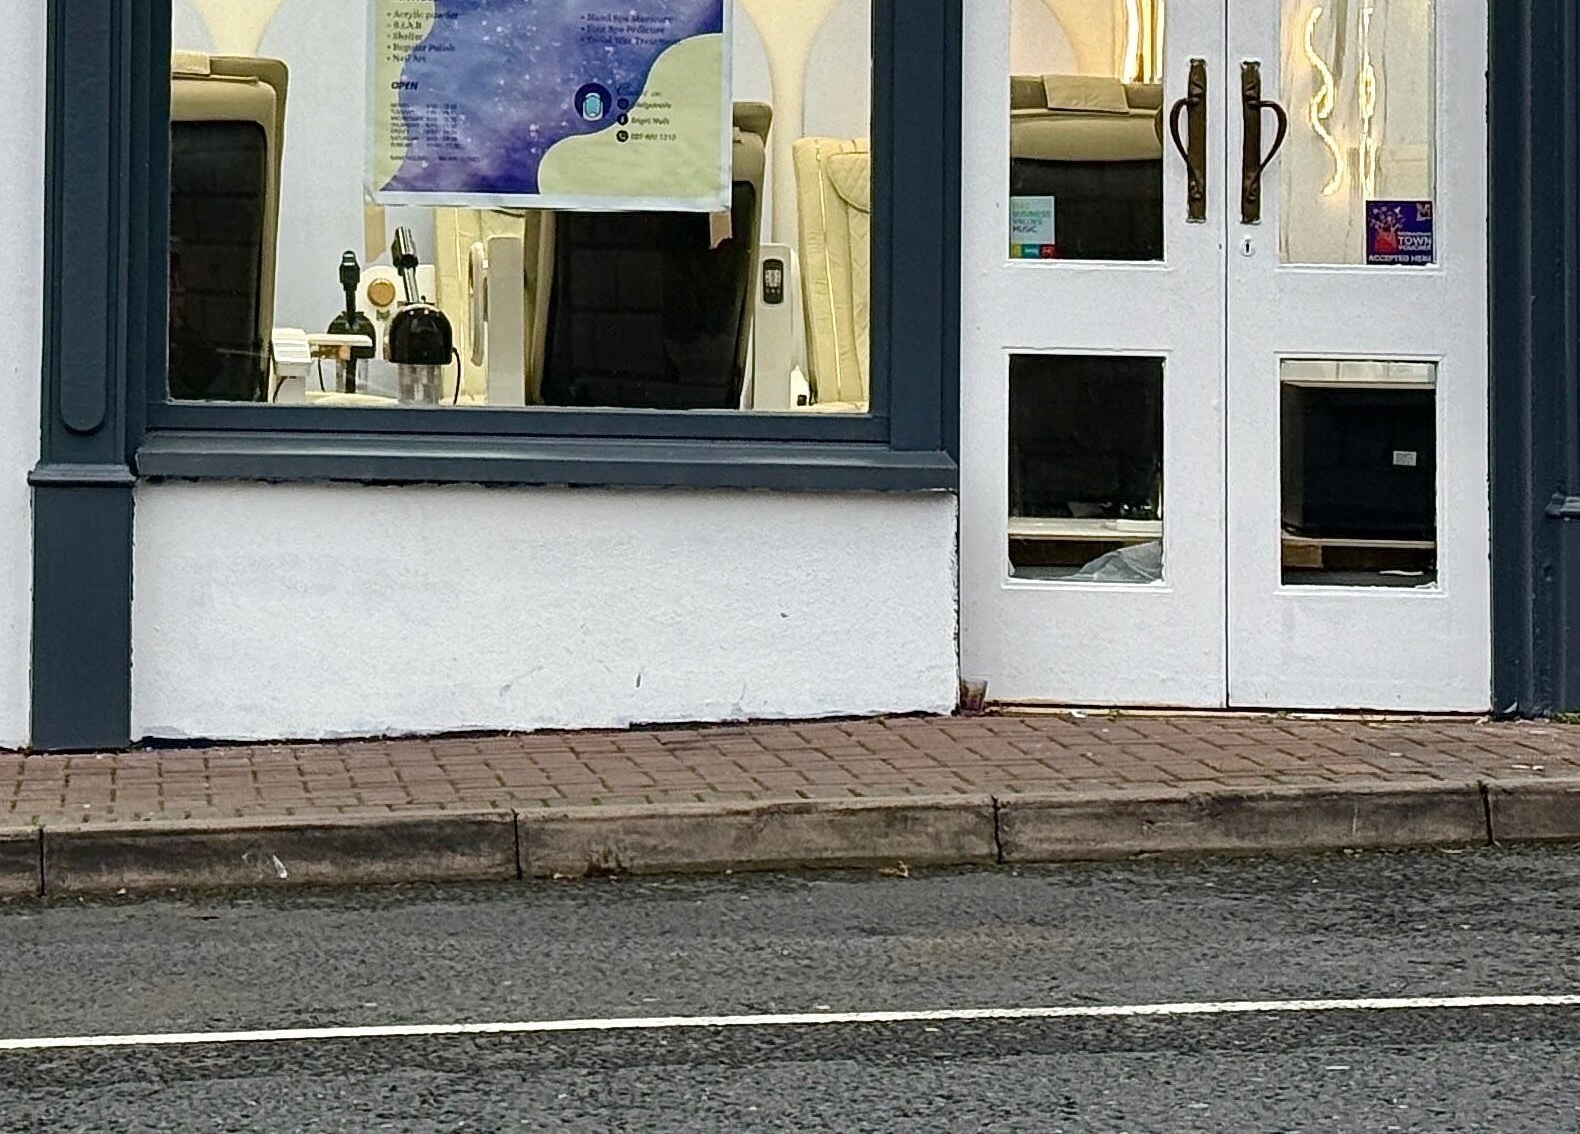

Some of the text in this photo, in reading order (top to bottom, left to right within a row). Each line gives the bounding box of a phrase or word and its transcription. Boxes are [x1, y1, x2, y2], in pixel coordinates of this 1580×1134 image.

[391, 82, 418, 90] OPEN
[1398, 236, 1432, 246] TOWN
[1369, 254, 1409, 262] ACCEPTED
